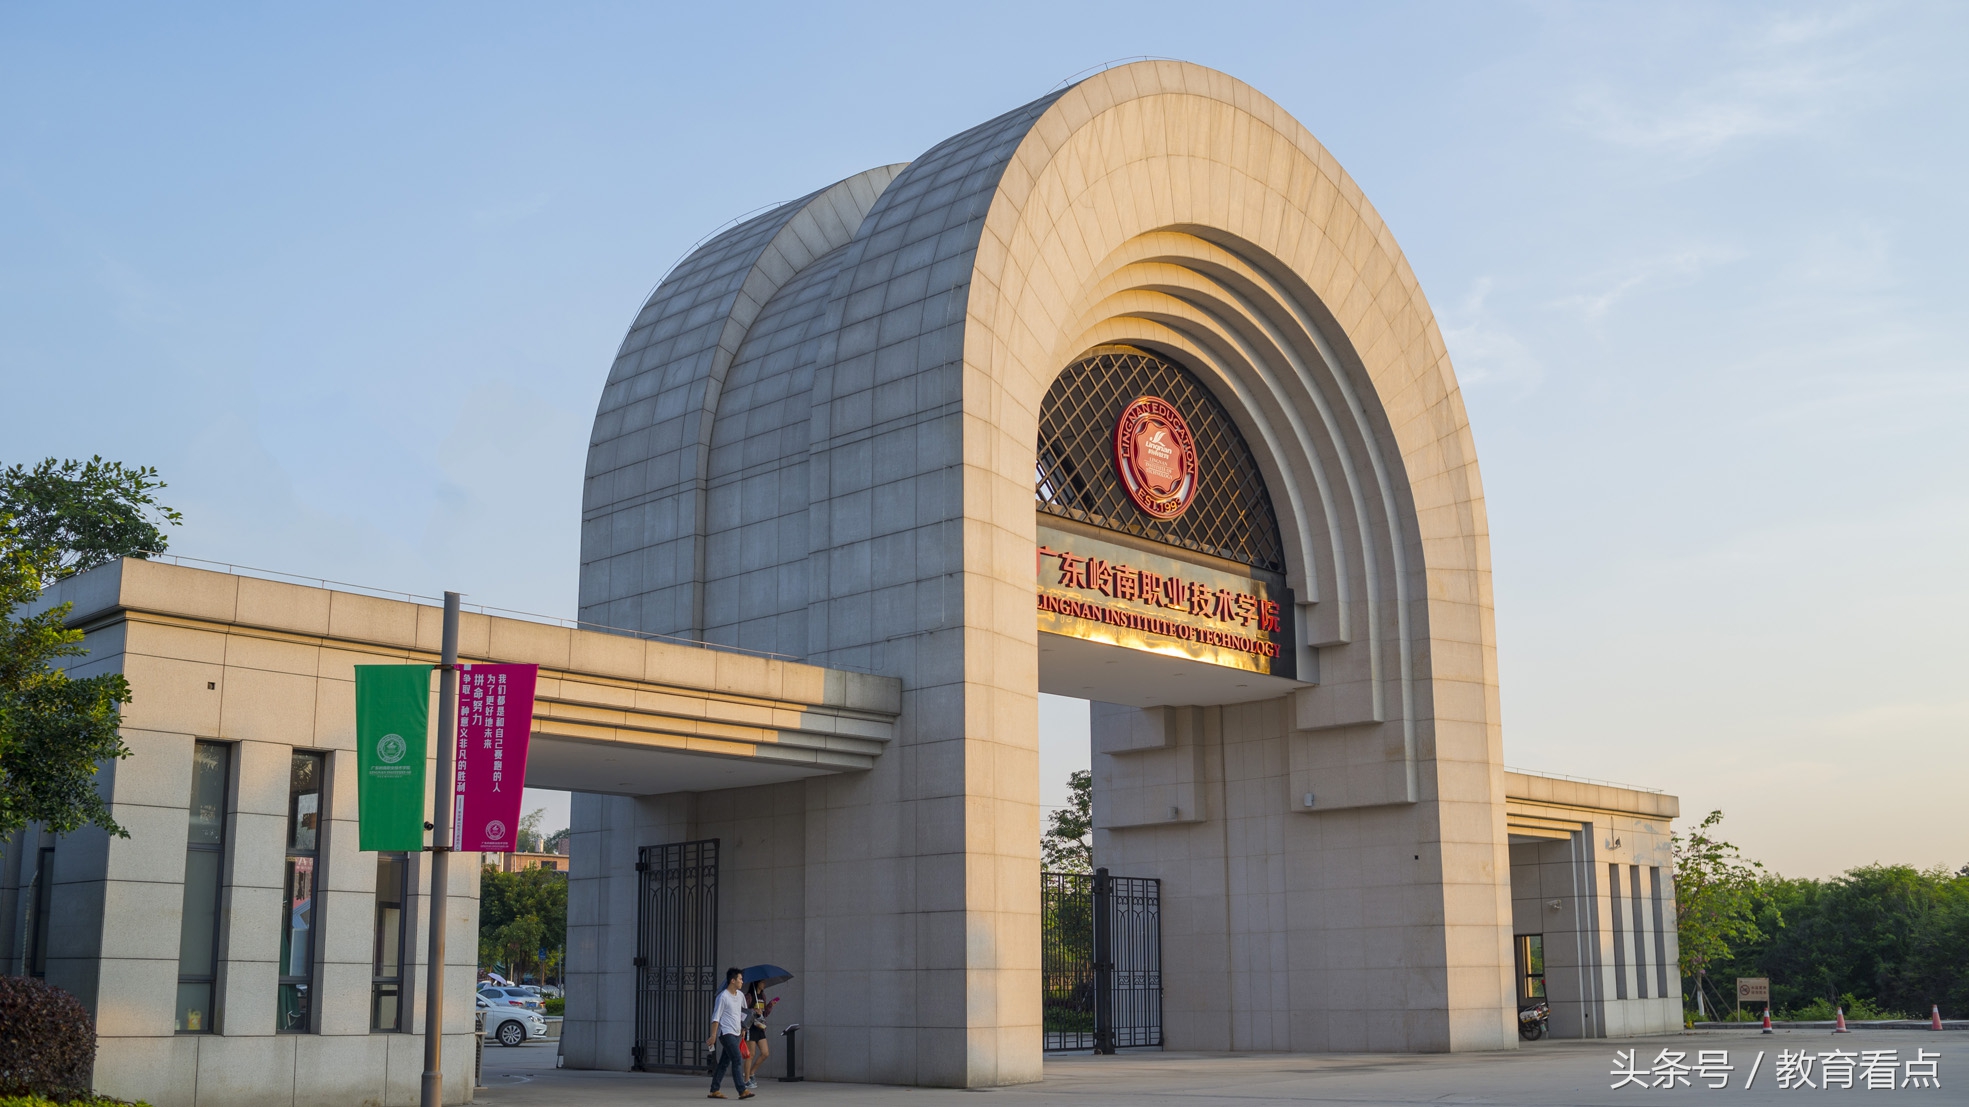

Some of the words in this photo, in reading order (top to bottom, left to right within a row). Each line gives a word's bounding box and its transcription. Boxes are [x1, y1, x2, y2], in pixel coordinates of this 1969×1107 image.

[1122, 403, 1151, 459] LINGNAN
[1151, 402, 1195, 474] EDUCATION
[1036, 546, 1281, 633] 广东岭南职业技术学院
[1103, 607, 1177, 636] INSTITUTE
[1176, 622, 1197, 640] OF
[1196, 627, 1281, 658] TECHNOLOGY
[456, 673, 472, 793] 争取一种意义非凡的胜利
[472, 673, 485, 726] 拼命努力
